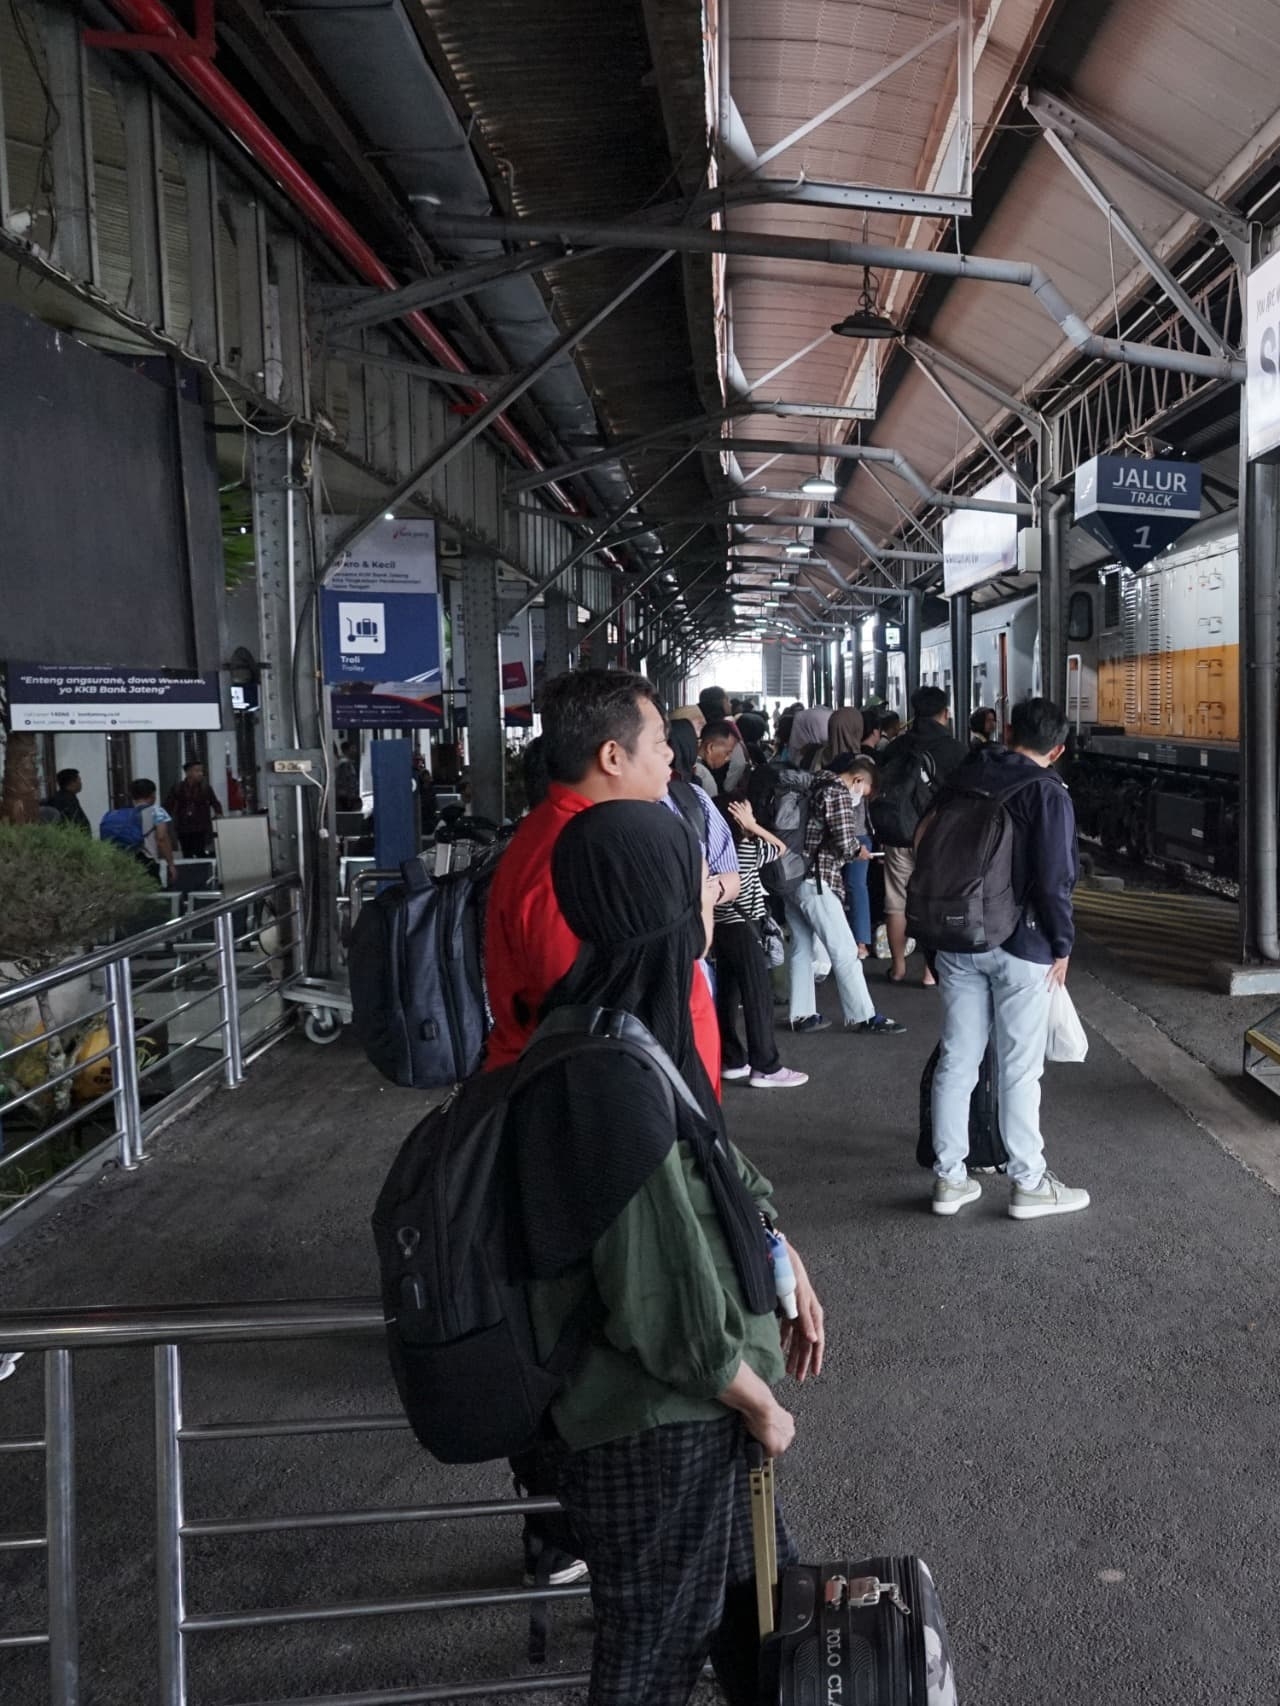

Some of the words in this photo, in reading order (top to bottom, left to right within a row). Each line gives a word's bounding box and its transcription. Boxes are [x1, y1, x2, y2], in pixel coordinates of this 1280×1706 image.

[1112, 467, 1187, 493] JALUR
[1130, 491, 1173, 506] TRACK
[1132, 525, 1152, 549] 1
[362, 560, 370, 569] &
[372, 560, 396, 569] Kecil
[340, 655, 361, 664] Troli
[66, 676, 126, 687] angsurane,
[59, 686, 72, 695] yo
[74, 685, 97, 694] KKB
[99, 686, 127, 694] Bank
